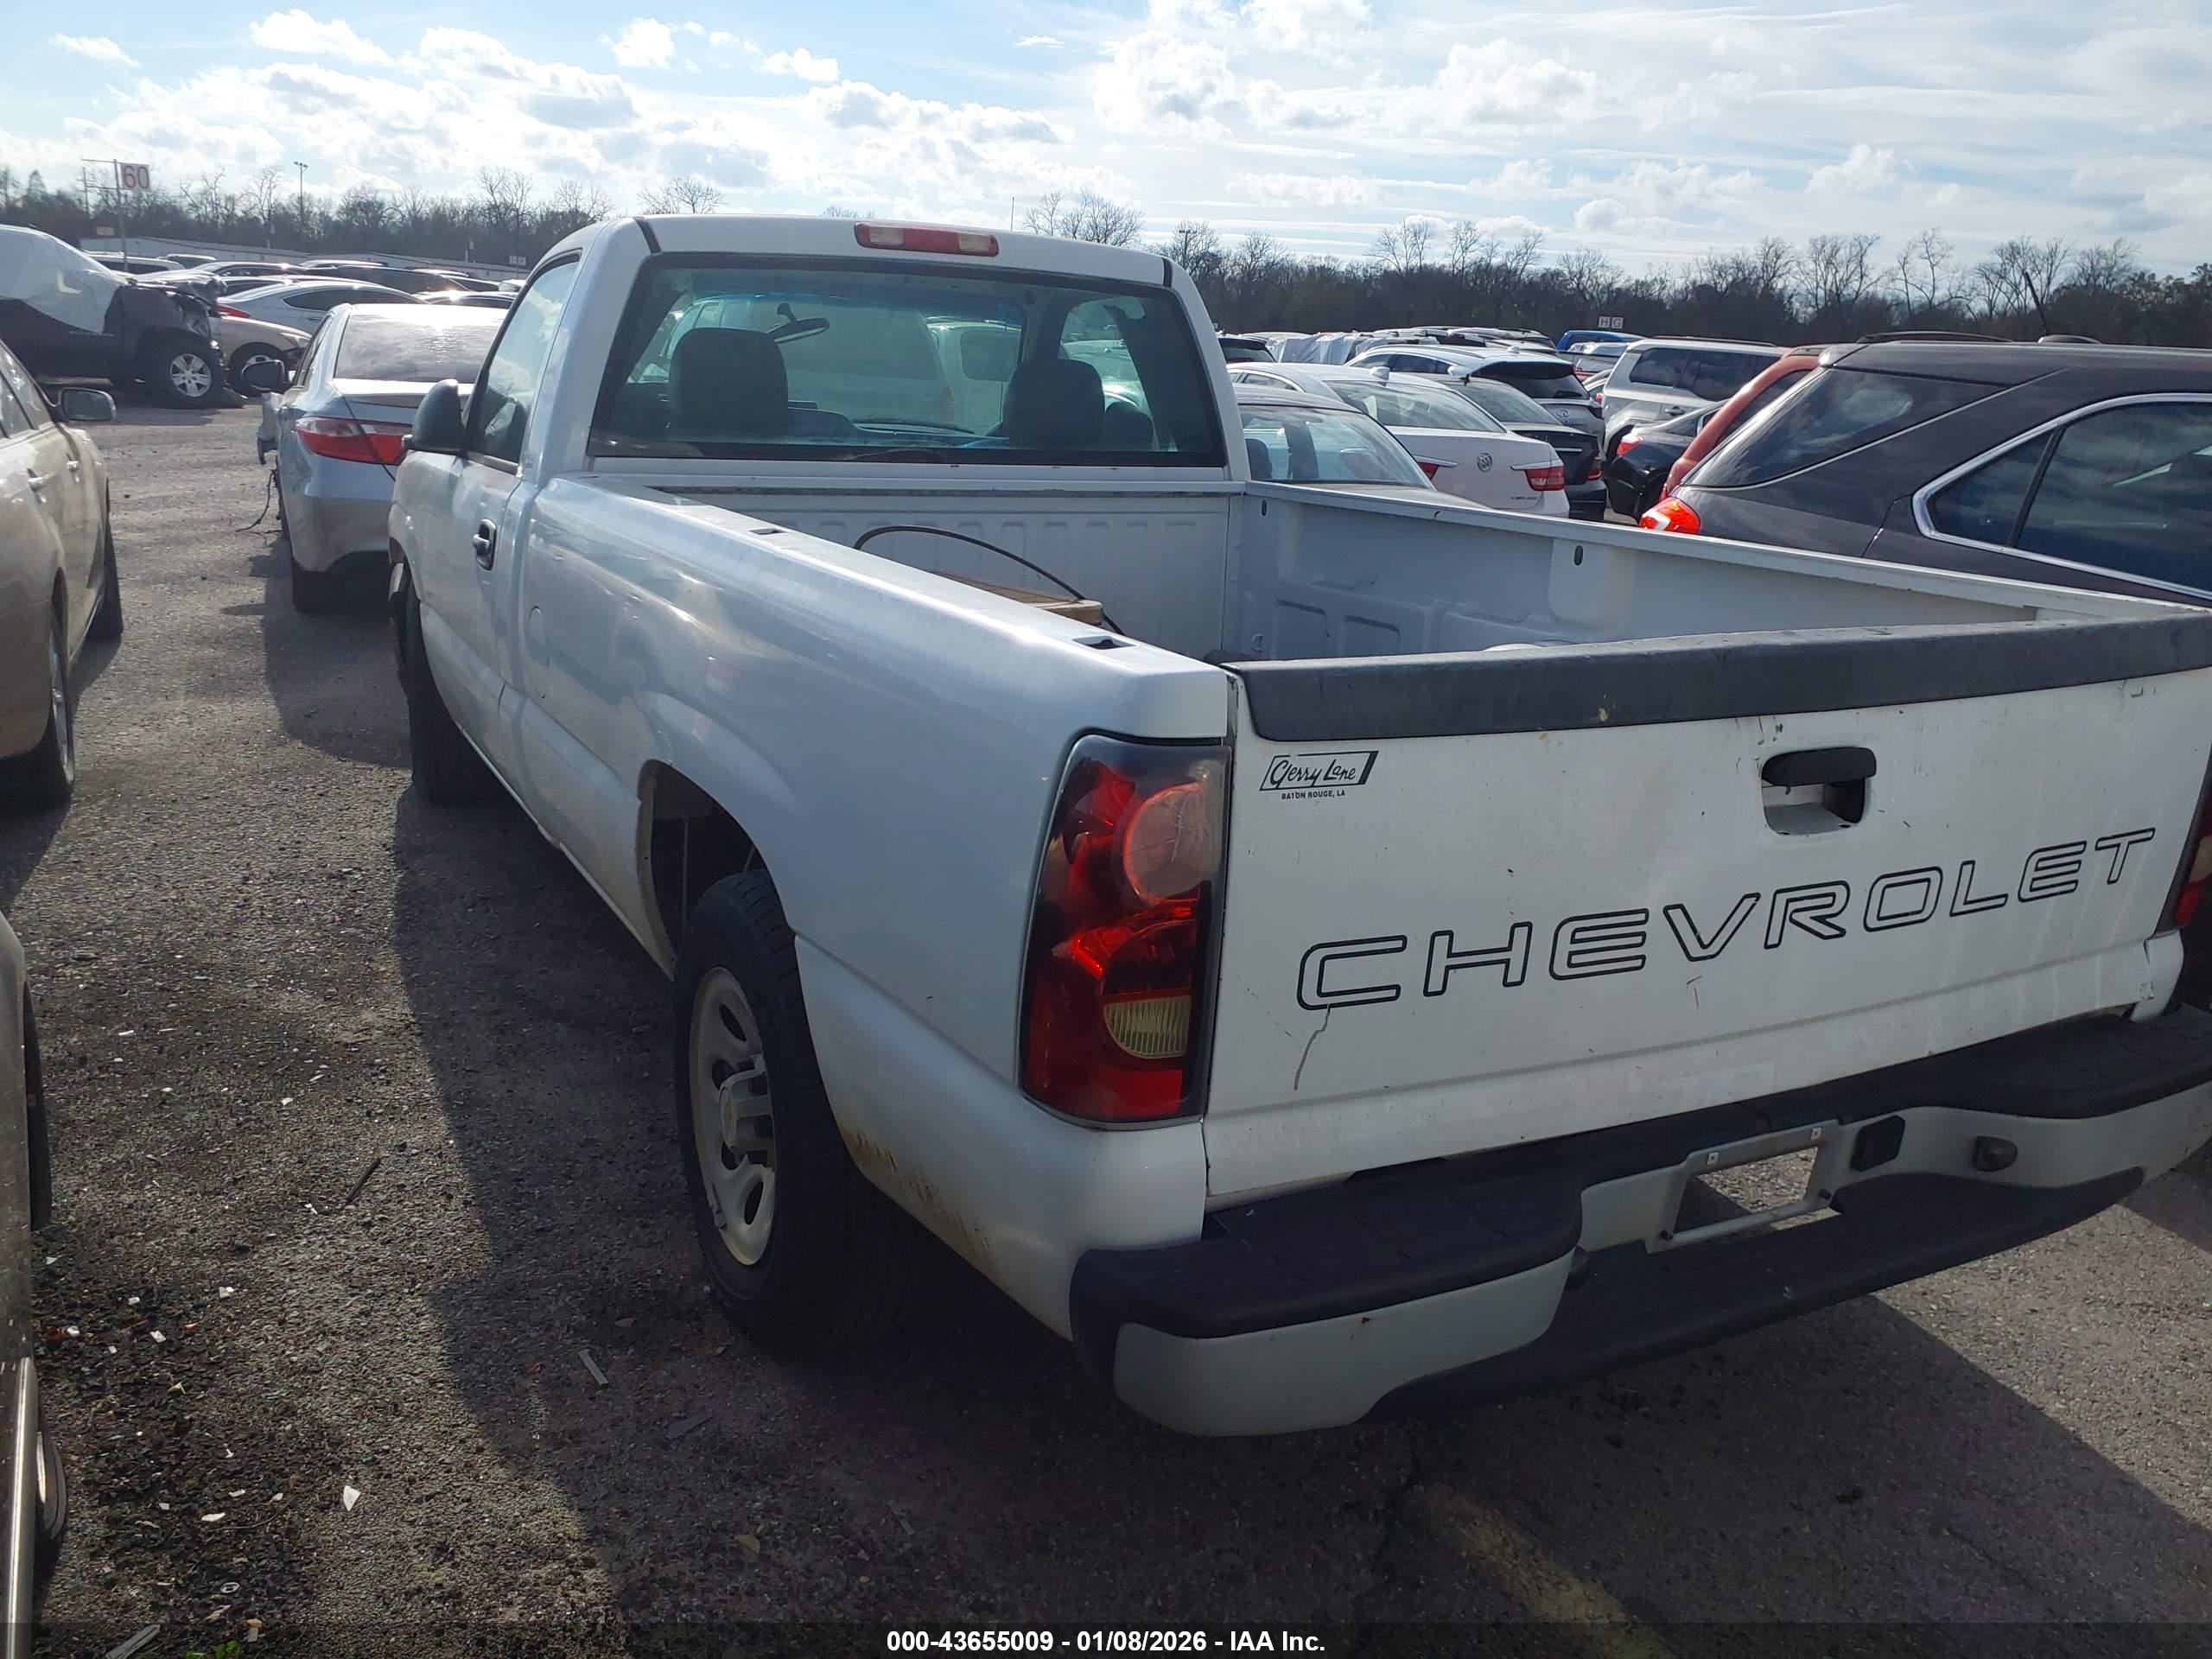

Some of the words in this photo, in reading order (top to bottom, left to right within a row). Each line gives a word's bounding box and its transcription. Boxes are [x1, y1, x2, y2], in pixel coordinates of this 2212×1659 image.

[124, 165, 149, 188] 60
[1270, 760, 1322, 788] Gerry
[1323, 759, 1356, 781] Lane
[1281, 791, 1306, 800] BATON
[1307, 790, 1335, 798] ROUGE,
[1296, 827, 2156, 1011] CHEVROLET
